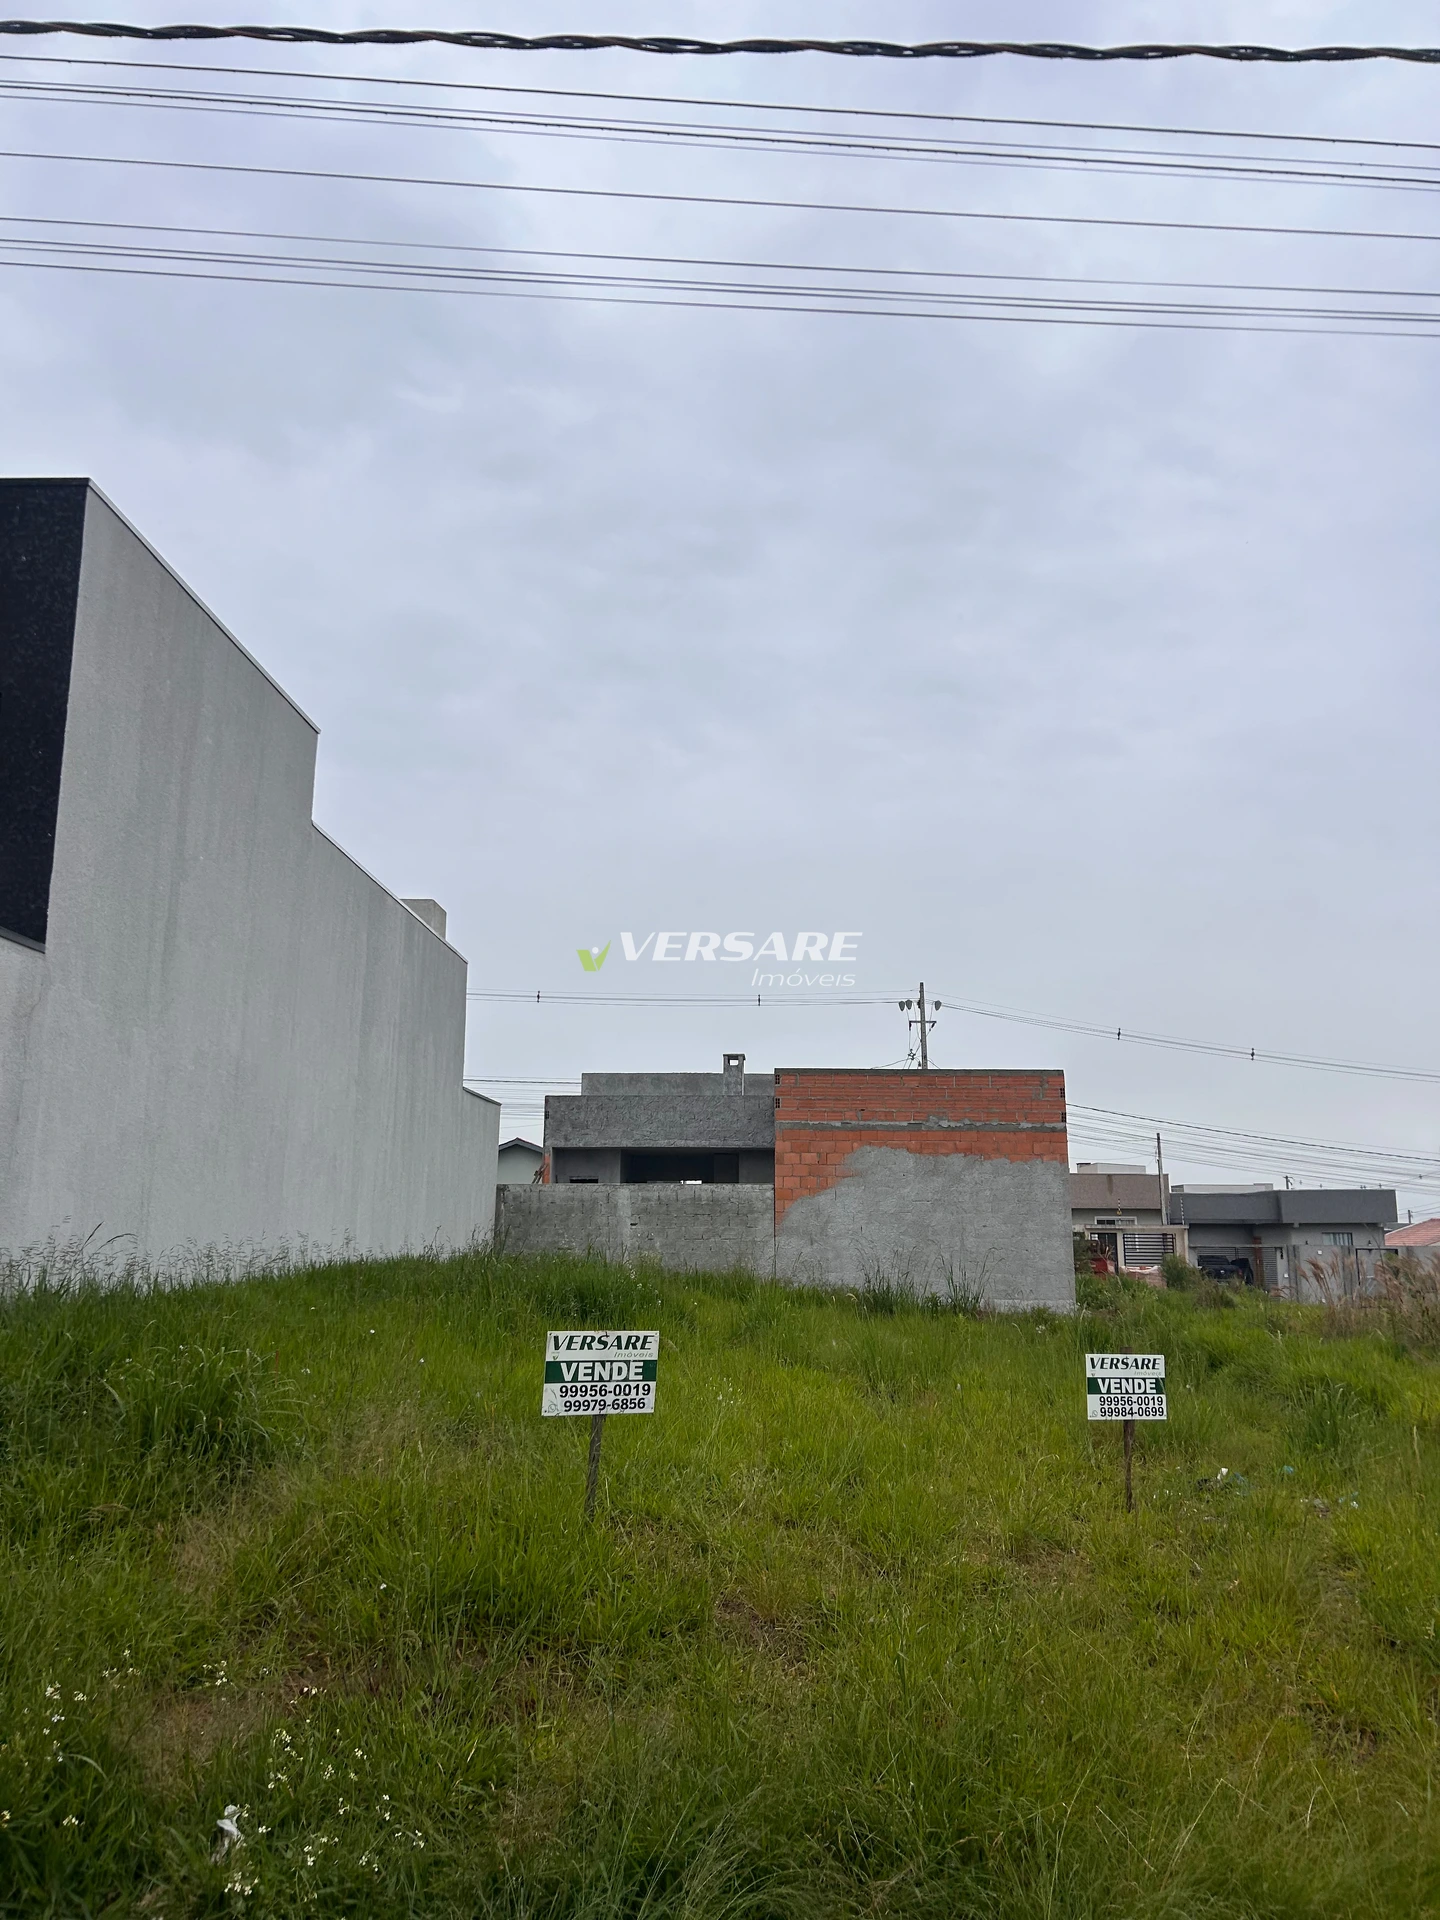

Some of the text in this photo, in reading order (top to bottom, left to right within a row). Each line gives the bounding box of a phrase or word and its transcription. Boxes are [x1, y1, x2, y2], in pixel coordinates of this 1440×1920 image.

[553, 1335, 655, 1350] VERSARE
[1090, 1357, 1161, 1370] VERSARE
[560, 1361, 644, 1381] VENDE
[559, 1384, 651, 1398] 99956-0019
[1097, 1378, 1157, 1394] VENDE
[563, 1398, 646, 1412] 99979-6856
[1099, 1396, 1163, 1406] 99956-0019
[1100, 1406, 1164, 1417] 99984-0699
